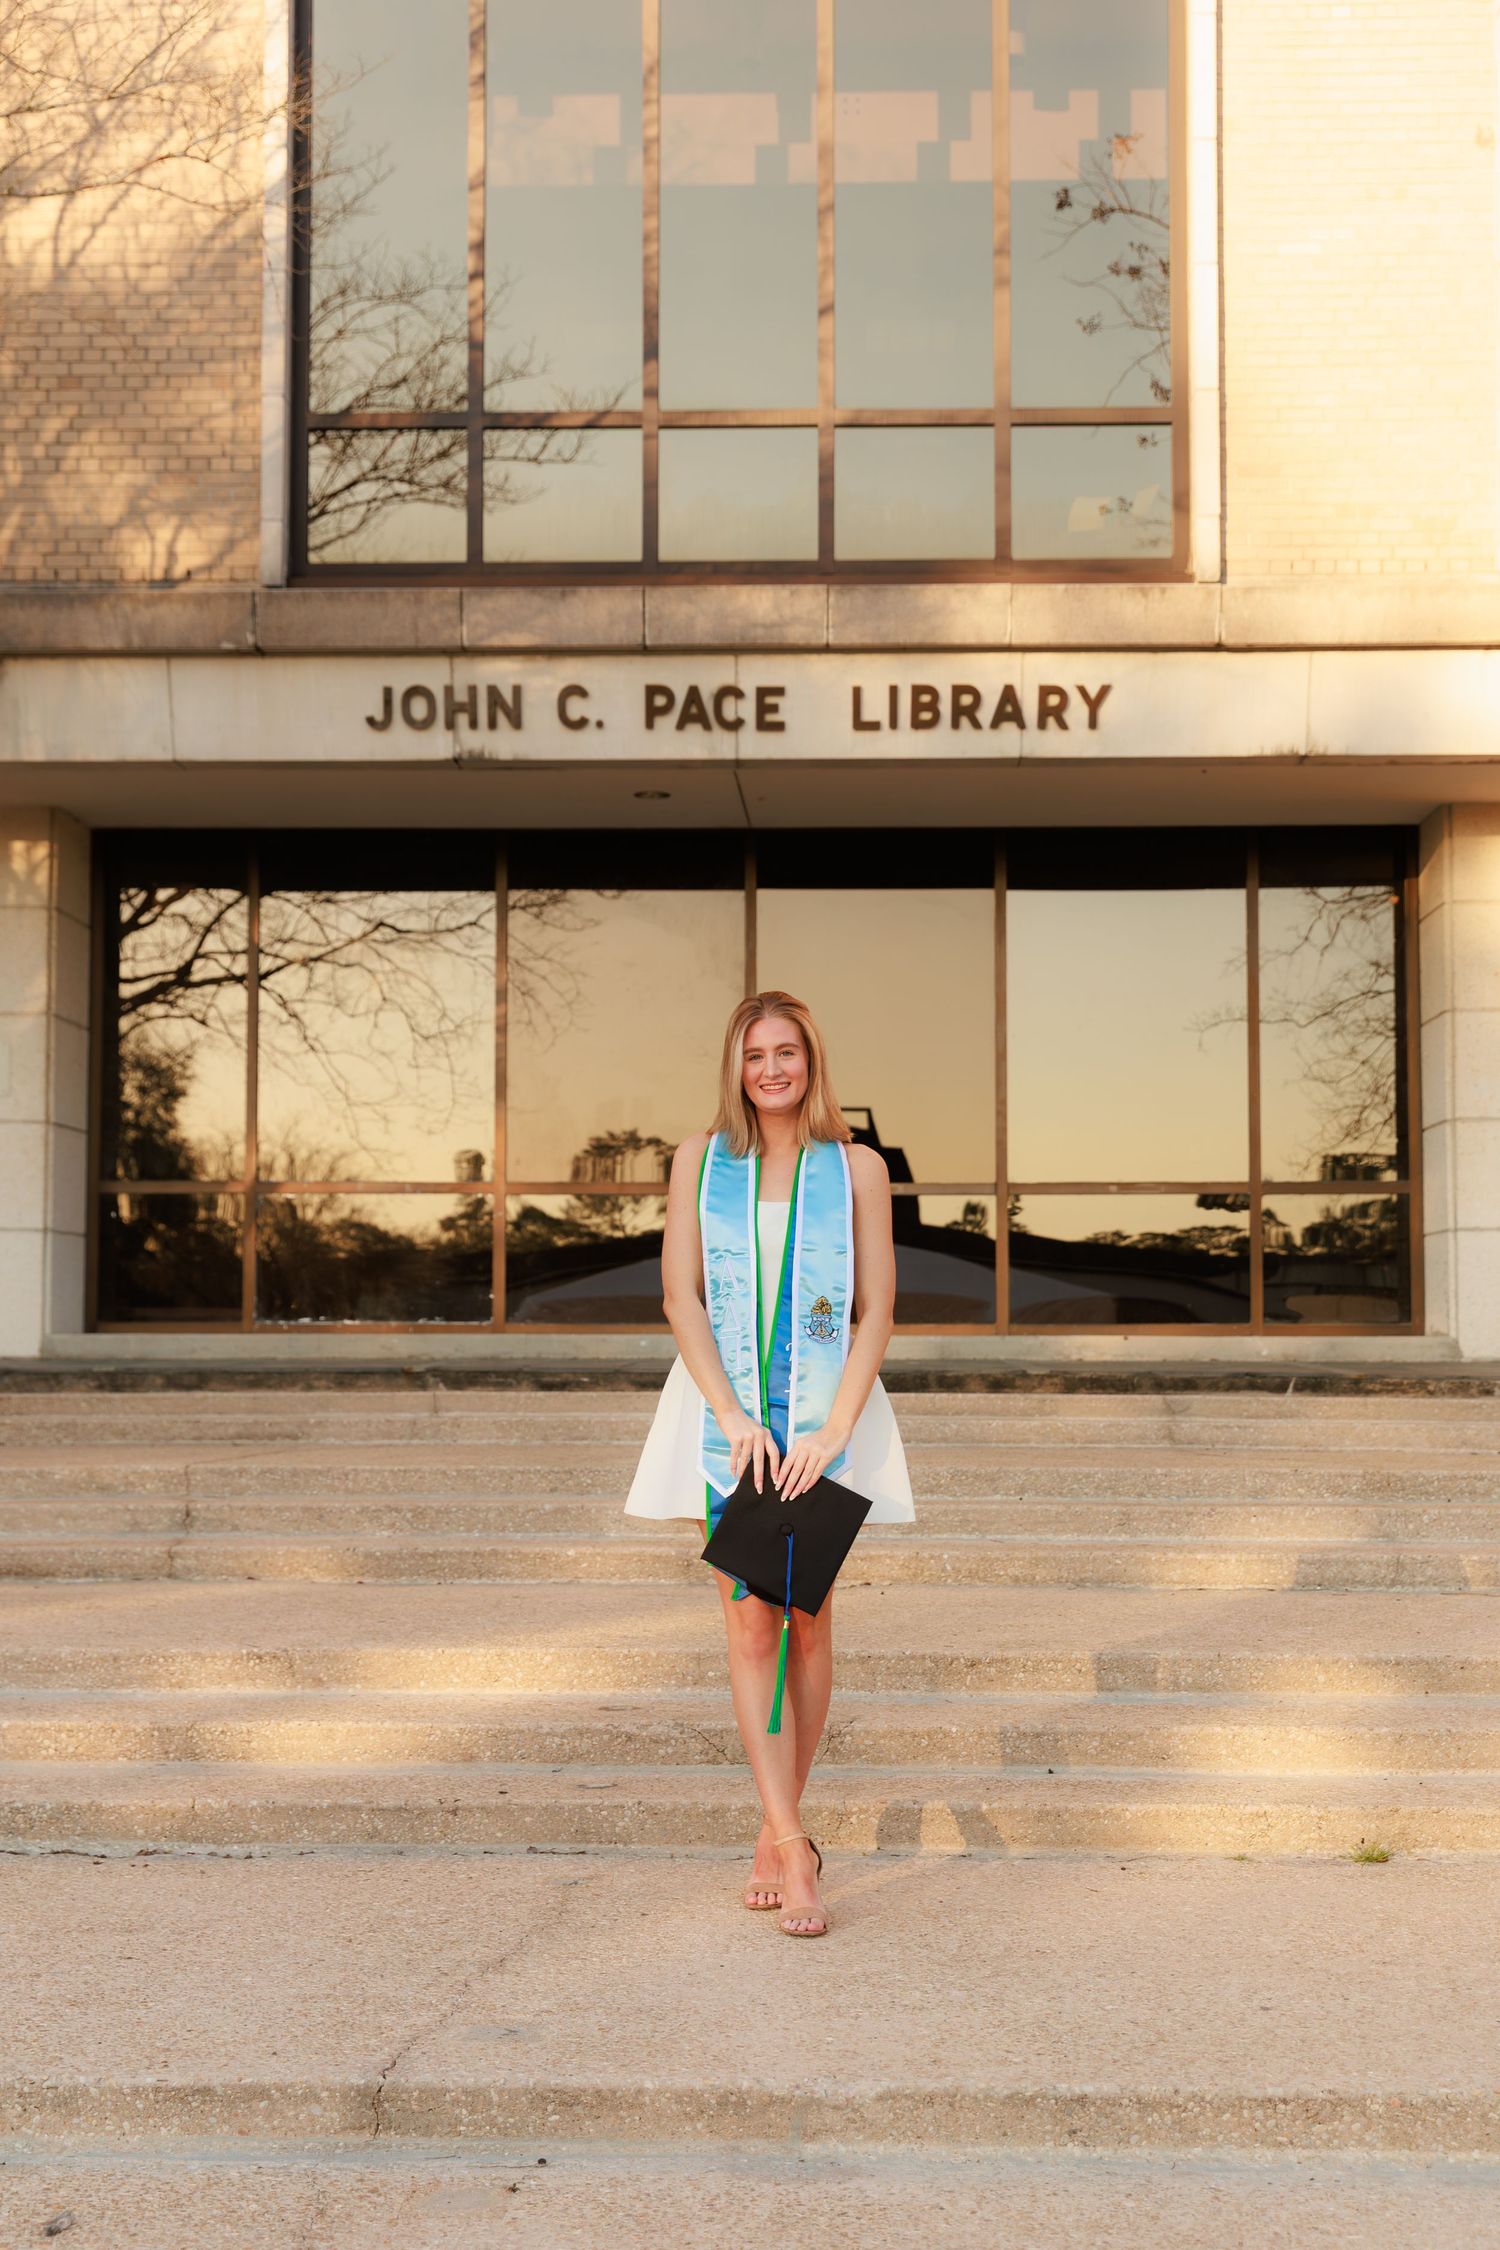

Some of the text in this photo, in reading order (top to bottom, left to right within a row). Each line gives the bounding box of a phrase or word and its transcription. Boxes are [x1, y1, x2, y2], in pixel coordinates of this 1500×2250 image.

[364, 684, 1112, 733] JOHN C. PACE LIBRARY
